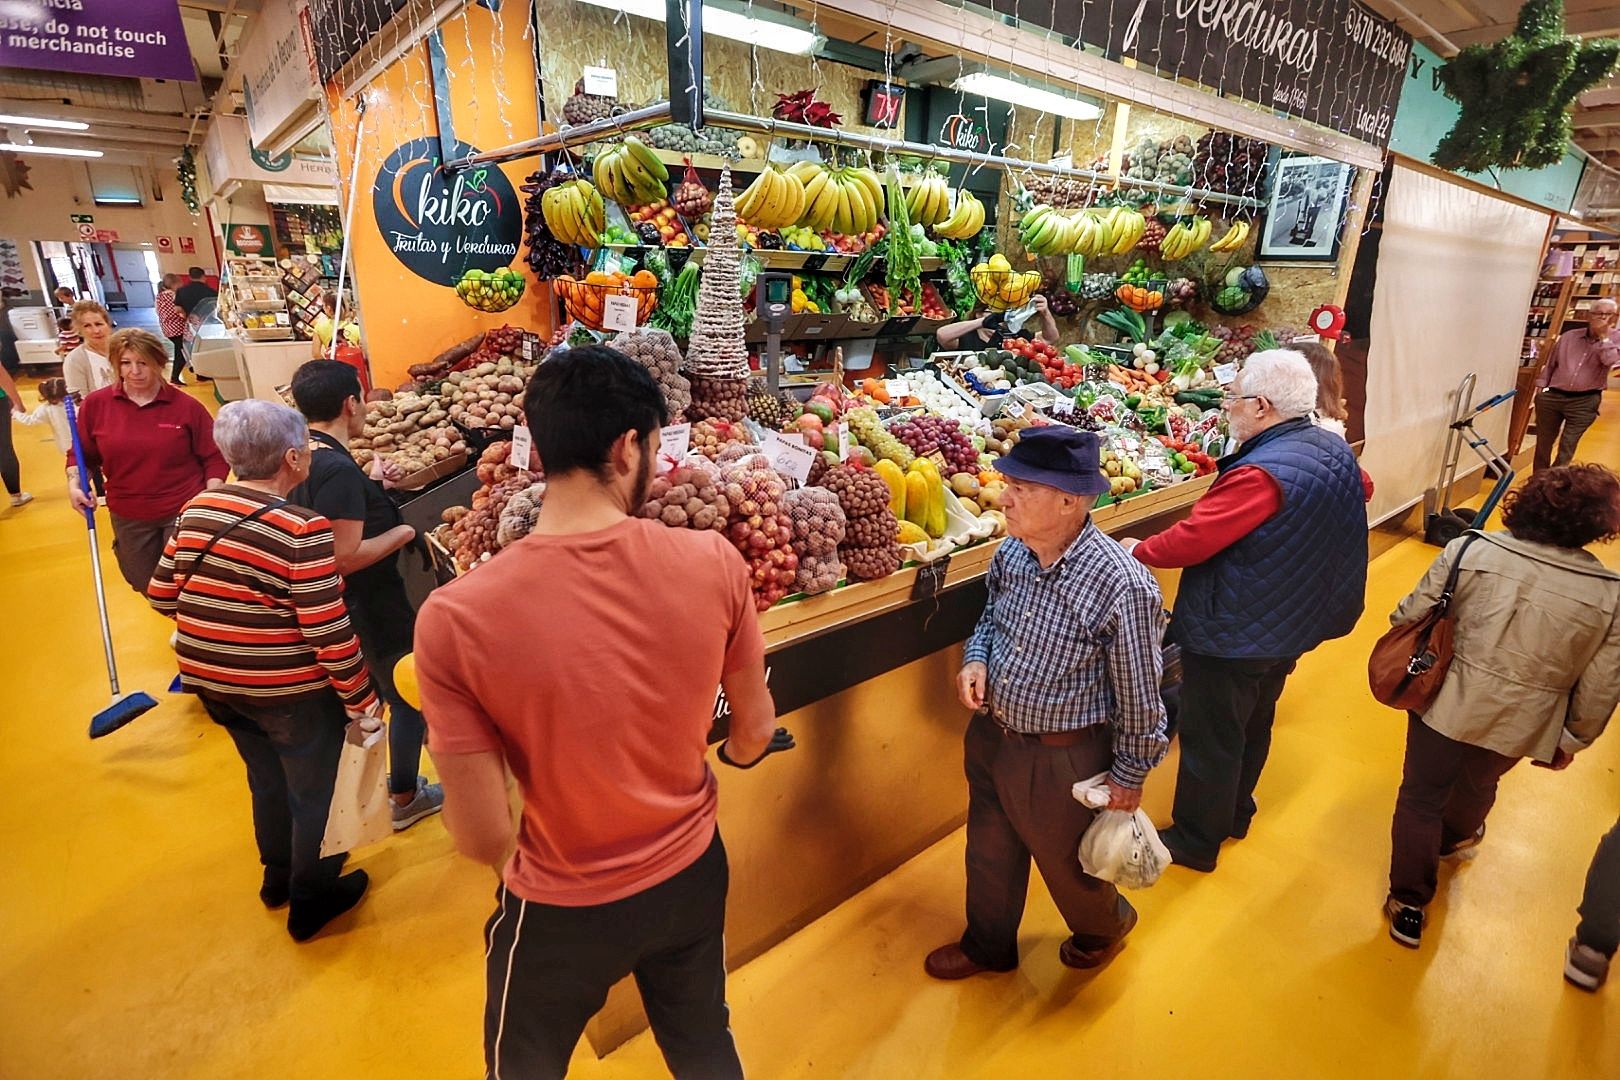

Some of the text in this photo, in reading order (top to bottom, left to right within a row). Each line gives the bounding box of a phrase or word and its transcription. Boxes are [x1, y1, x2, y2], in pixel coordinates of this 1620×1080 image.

[9, 34, 135, 58] merchandise
[45, 19, 70, 35] do
[77, 25, 109, 39] not
[115, 27, 167, 46] touch
[1353, 13, 1409, 70] 670 232 684
[1411, 52, 1425, 79] Y
[956, 120, 979, 149] kiko
[1356, 103, 1390, 139] Local 22
[418, 172, 491, 226] kiko
[390, 231, 516, 263] Frutas y Verduras
